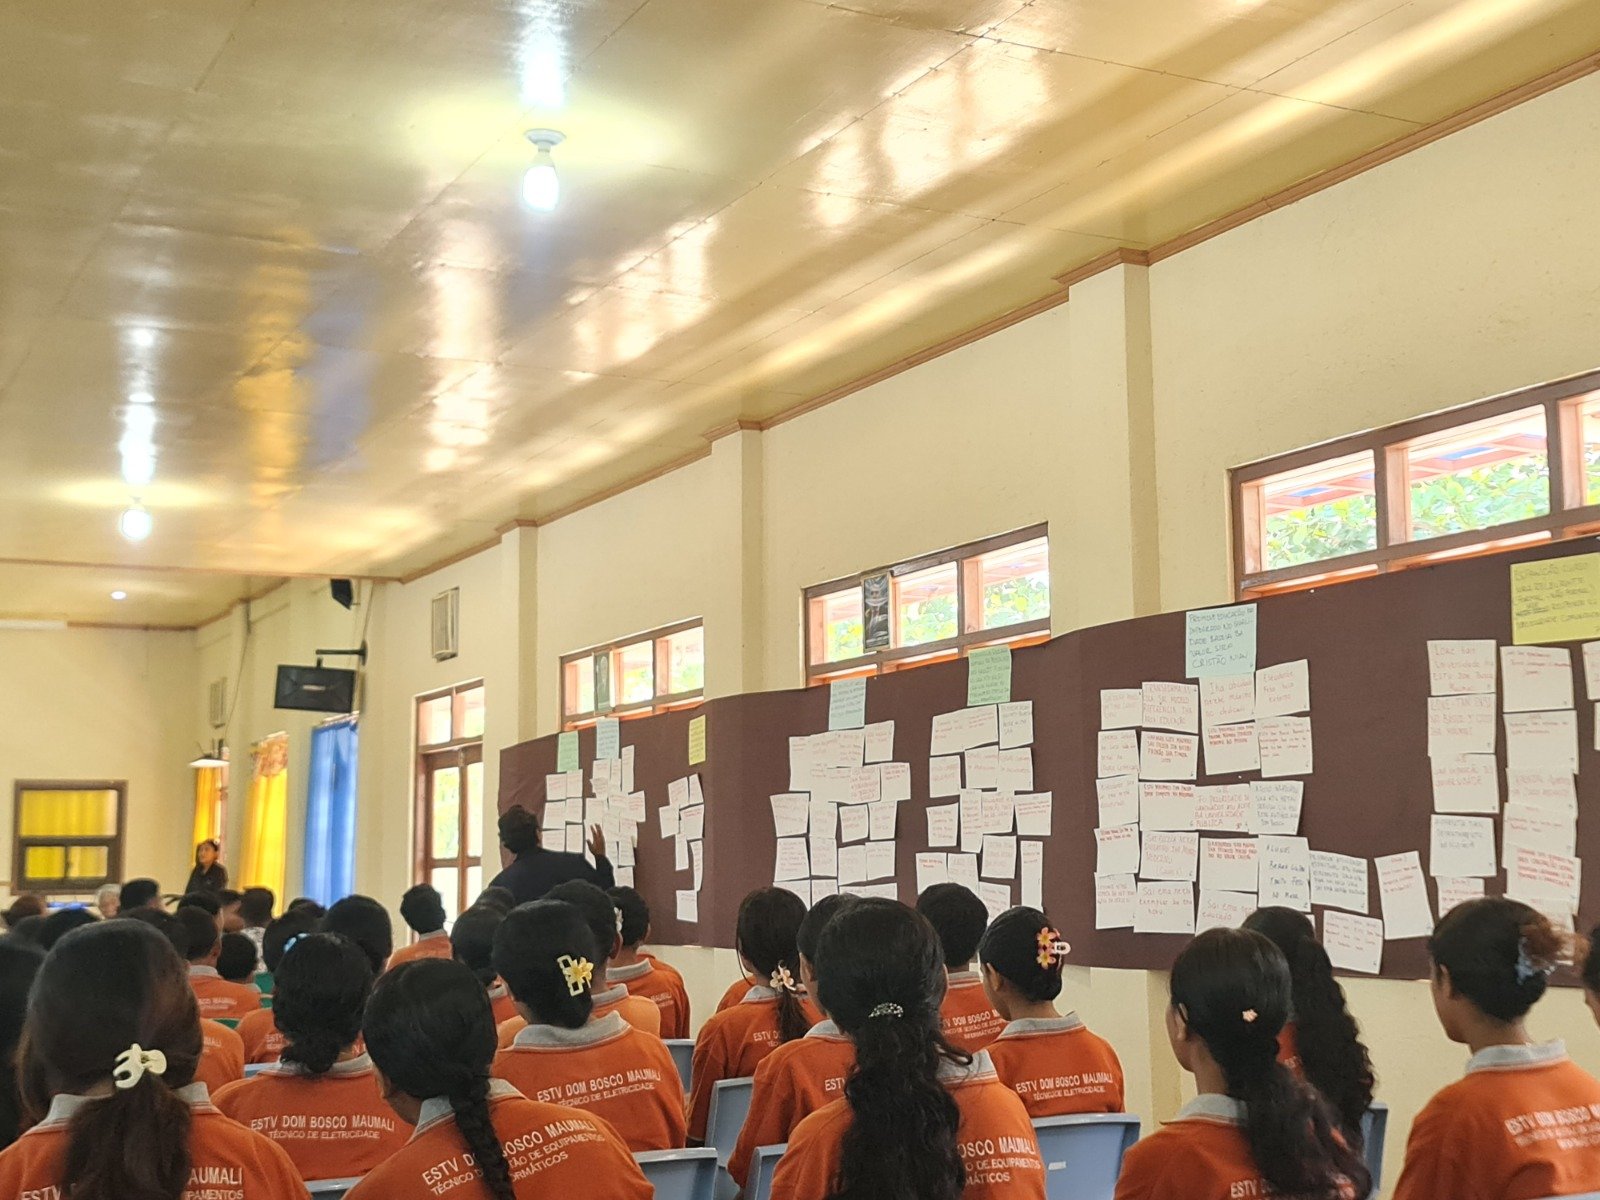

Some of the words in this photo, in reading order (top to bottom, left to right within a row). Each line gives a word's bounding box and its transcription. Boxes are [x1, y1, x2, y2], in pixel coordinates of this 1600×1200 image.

[537, 1086, 563, 1103] ESTV
[565, 1081, 588, 1096] DOM
[590, 1074, 624, 1091] BOSCO
[1015, 1080, 1038, 1093] ESTV
[1039, 1077, 1055, 1090] DOM
[1055, 1074, 1081, 1088] BOSCO
[250, 1115, 279, 1132] ESTV
[282, 1115, 307, 1128] DOM
[310, 1115, 348, 1129] BOSCO
[352, 1114, 396, 1132] MAUMALI
[307, 1131, 320, 1140] DE
[503, 1130, 544, 1159] OSCO
[544, 1119, 599, 1139] MAUMALI
[957, 1139, 995, 1159] OSCO
[421, 1157, 459, 1187] ESTV
[976, 1160, 990, 1171] DE
[187, 1166, 244, 1186] AUMALI
[430, 1171, 475, 1197] TÉCNICO
[1230, 1179, 1257, 1199] ESTV
